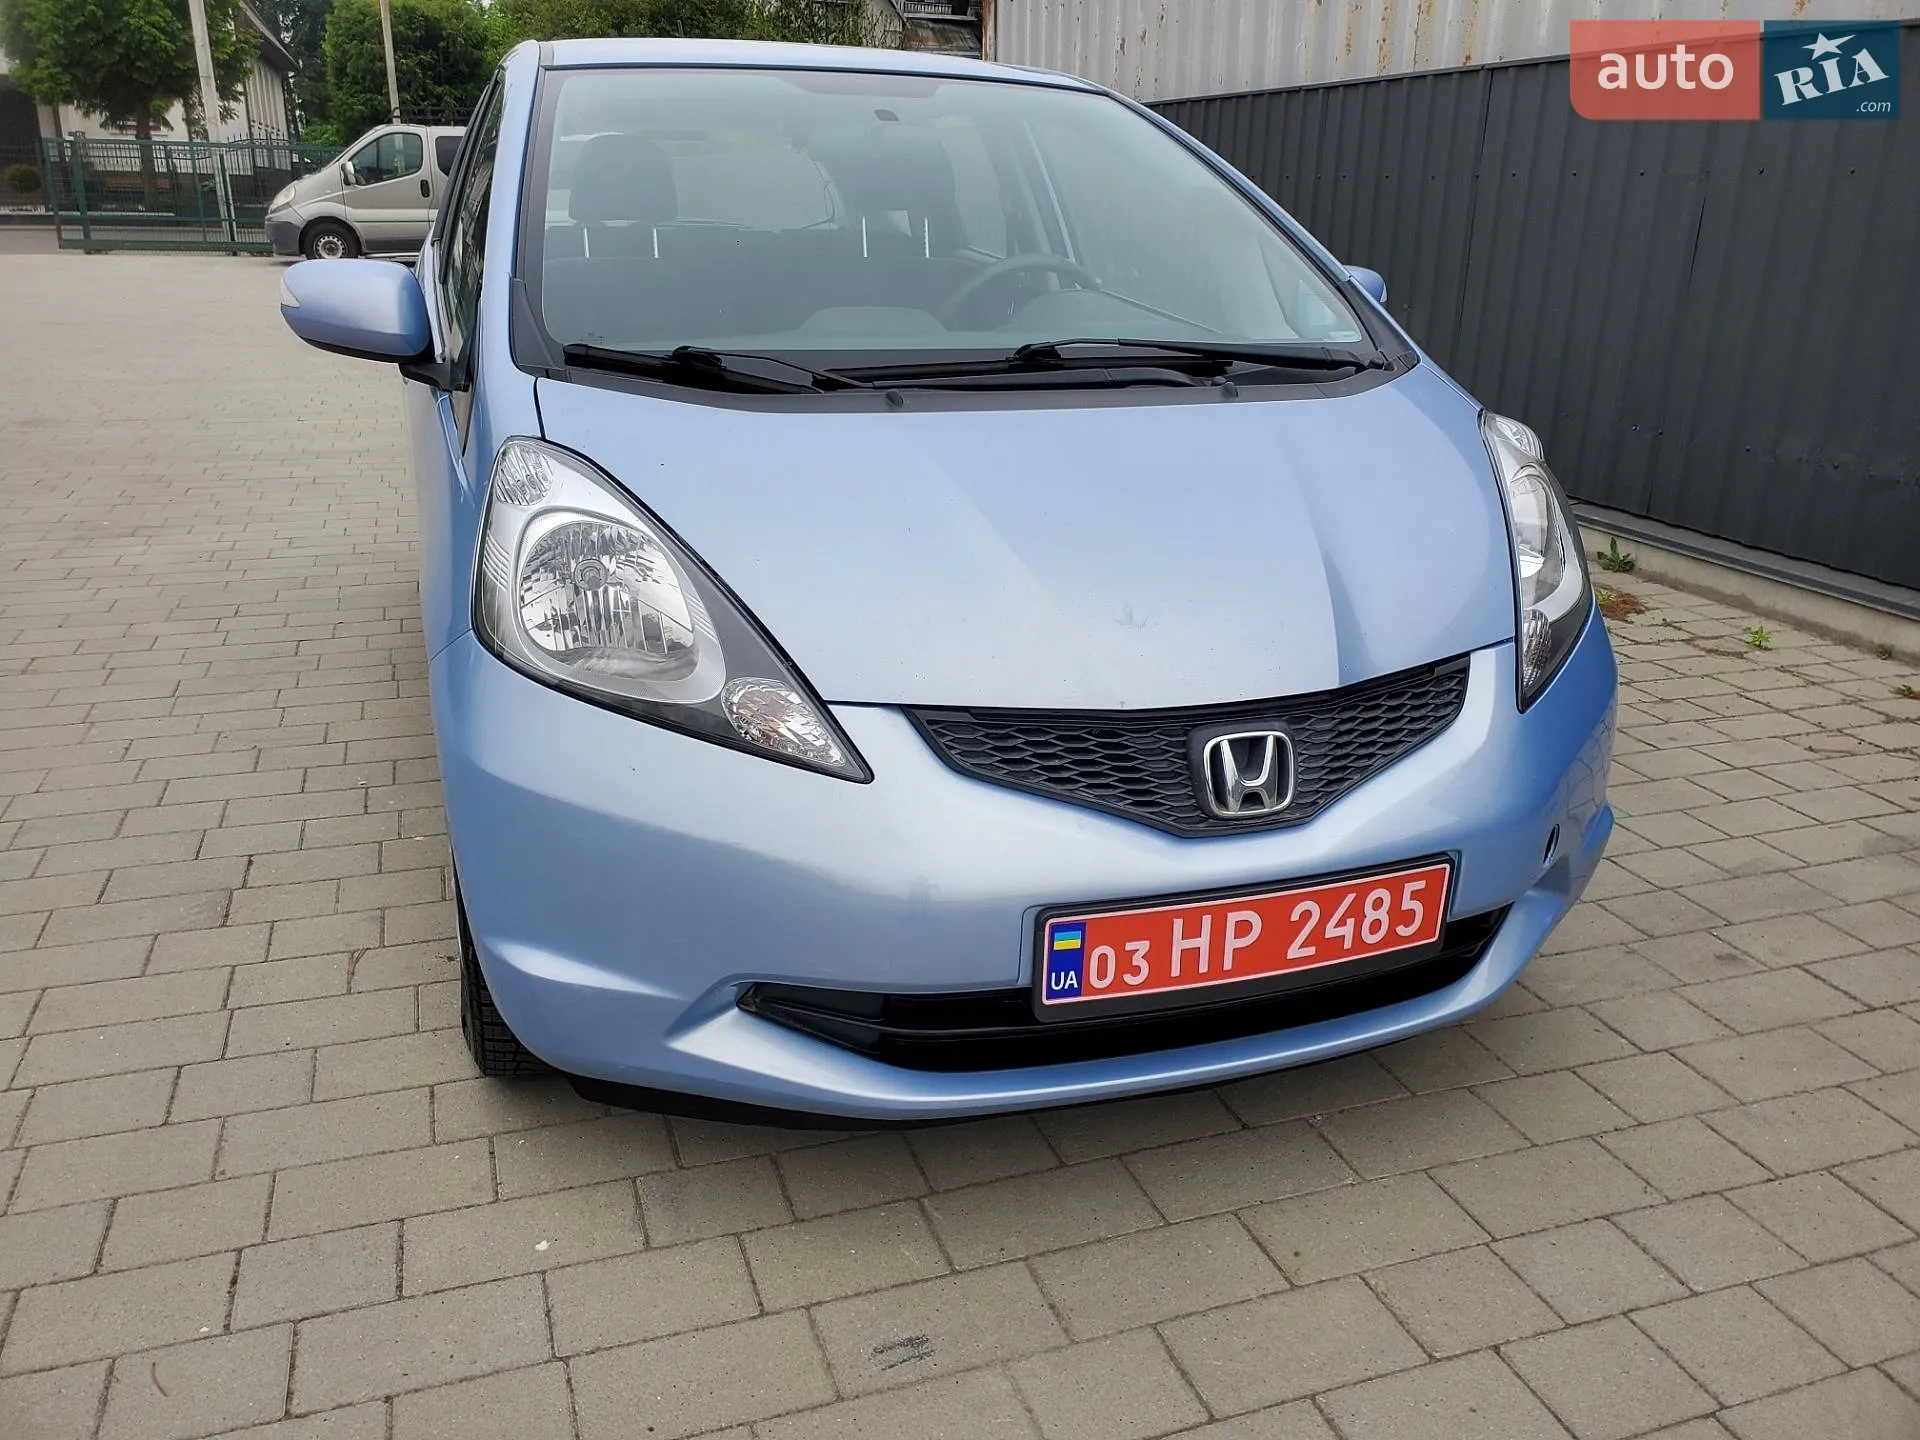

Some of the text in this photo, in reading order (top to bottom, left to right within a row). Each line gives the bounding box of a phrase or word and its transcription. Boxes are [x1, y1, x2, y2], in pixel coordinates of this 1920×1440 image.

[1088, 879, 1428, 989] 03 HP 2485
[1050, 969, 1079, 991] UA
